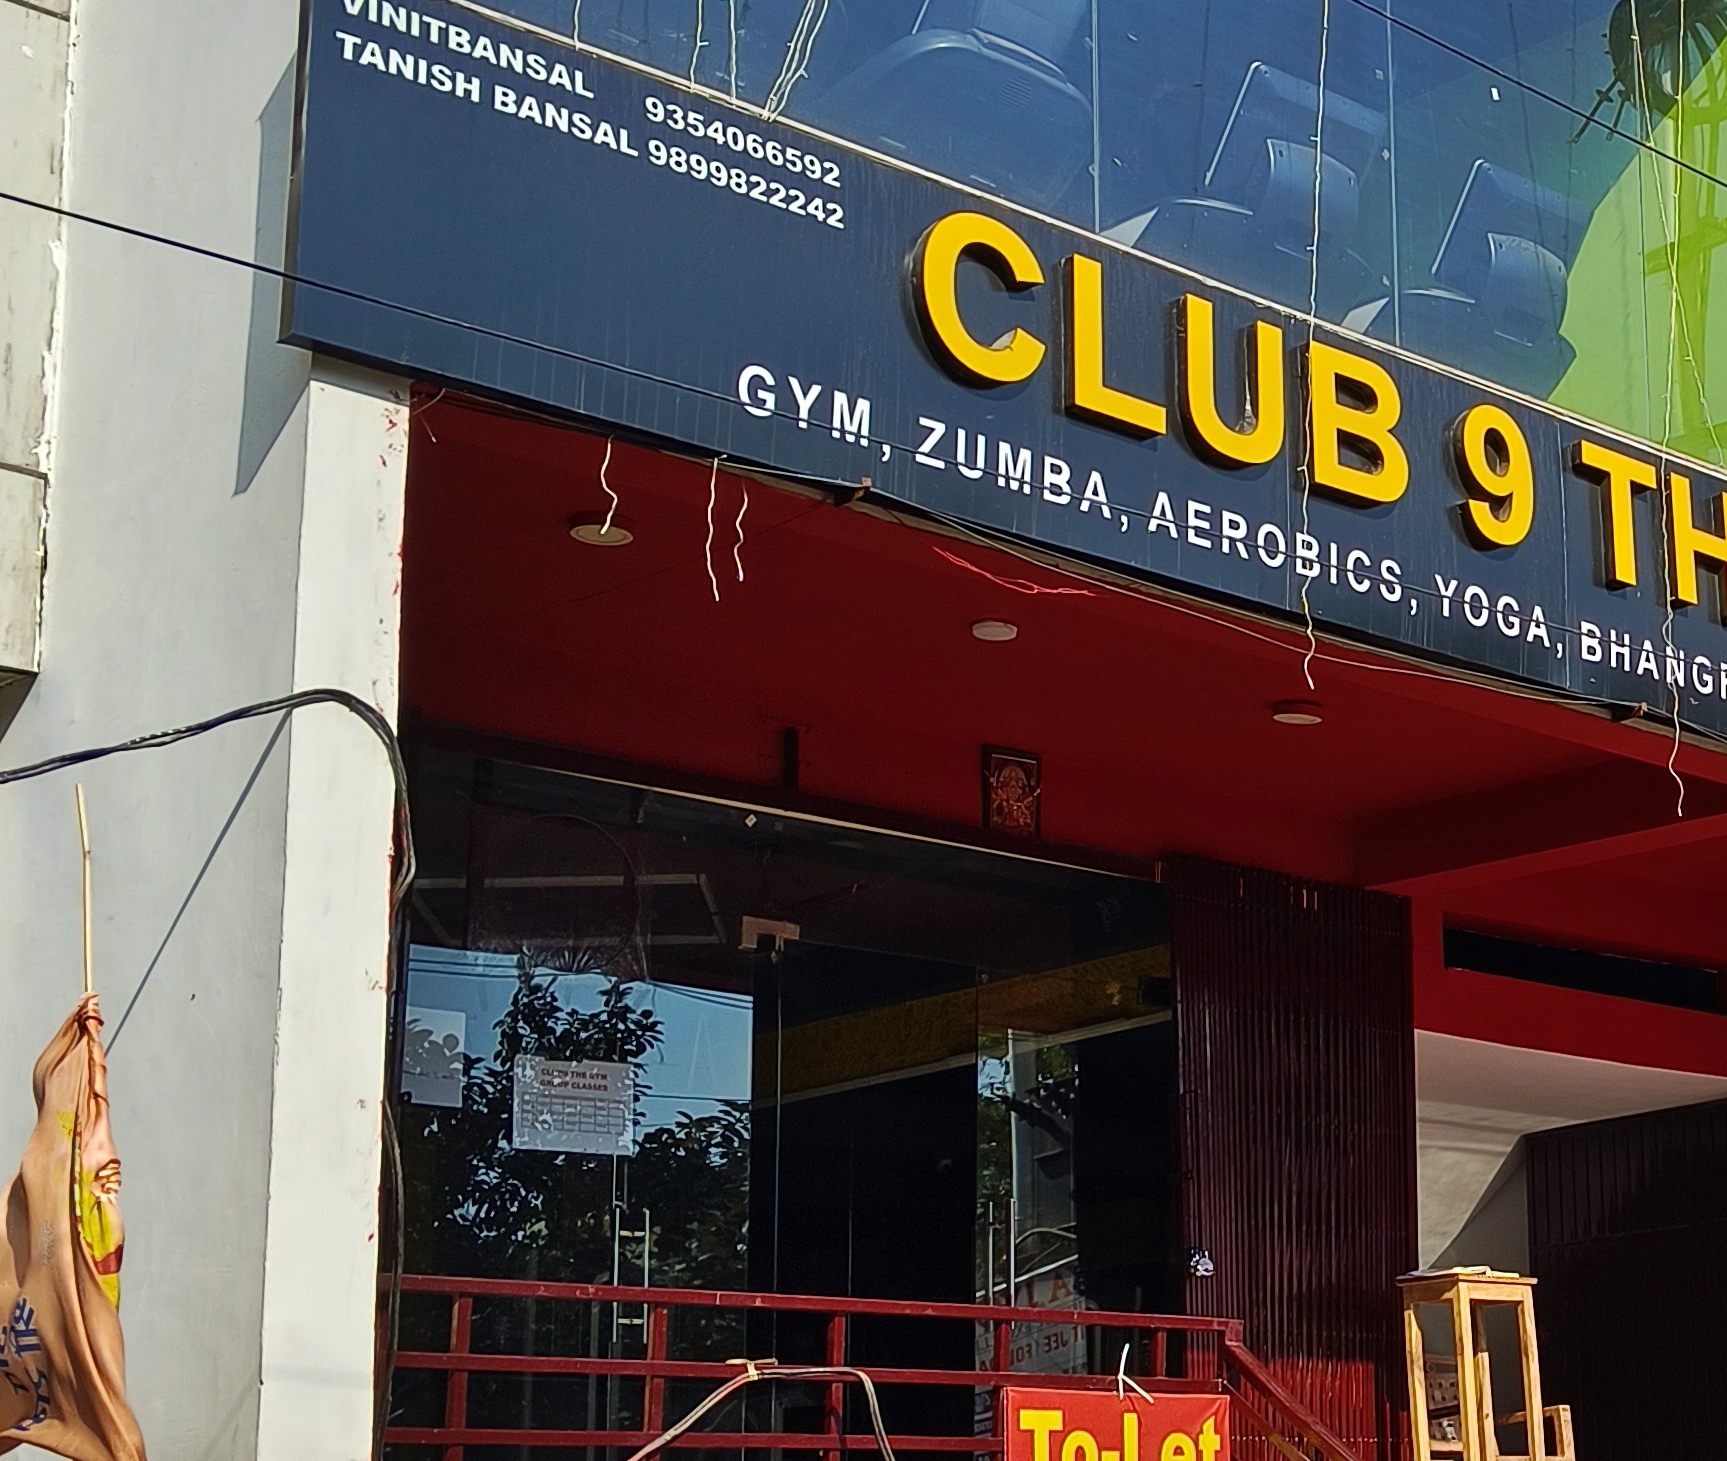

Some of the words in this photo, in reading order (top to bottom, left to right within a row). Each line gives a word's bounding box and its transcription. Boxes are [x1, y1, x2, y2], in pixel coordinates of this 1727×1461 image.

[336, 31, 480, 103] TANISH
[493, 85, 638, 156] BANSAL
[648, 138, 845, 229] 9899822242
[644, 96, 842, 187] 9354066592
[922, 211, 1410, 504] CLUB
[1463, 403, 1535, 546] 9
[737, 365, 893, 461] GYM,
[915, 416, 1130, 534] ZUMBA,
[1148, 491, 1419, 616] AEROBICS,
[1433, 574, 1563, 659] YOGA,
